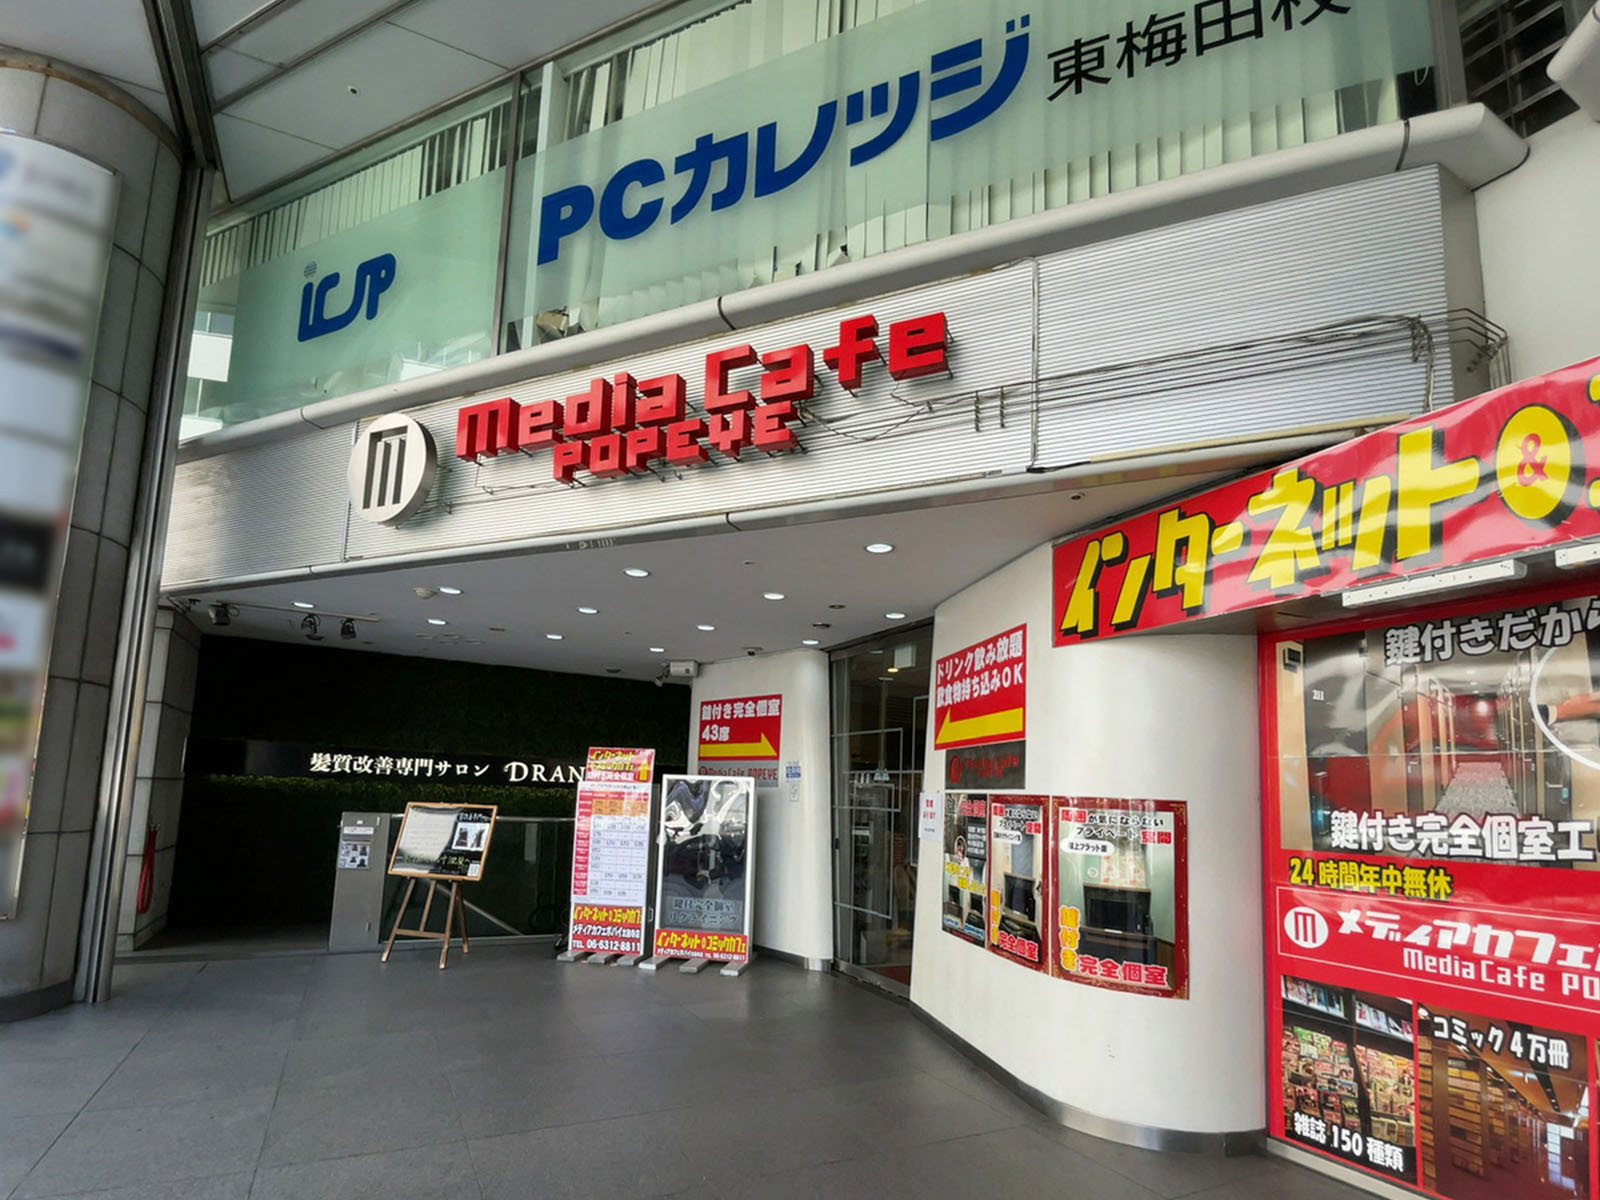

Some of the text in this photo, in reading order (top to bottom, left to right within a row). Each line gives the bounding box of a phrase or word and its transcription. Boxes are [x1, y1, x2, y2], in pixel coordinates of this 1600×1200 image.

[537, 14, 1029, 266] PCカレッジ
[456, 312, 948, 463] Media Cafe
[554, 400, 800, 483] POPEYE
[1060, 425, 1481, 635] インターネット
[936, 631, 1023, 684] ドリンク飲み放題
[936, 662, 1024, 708] 飲食物持ち込みOK
[310, 752, 585, 783] 髪質改善専門サロン DRAN
[1079, 955, 1168, 986] 完全個室
[1338, 909, 1600, 972] メディアカフェ
